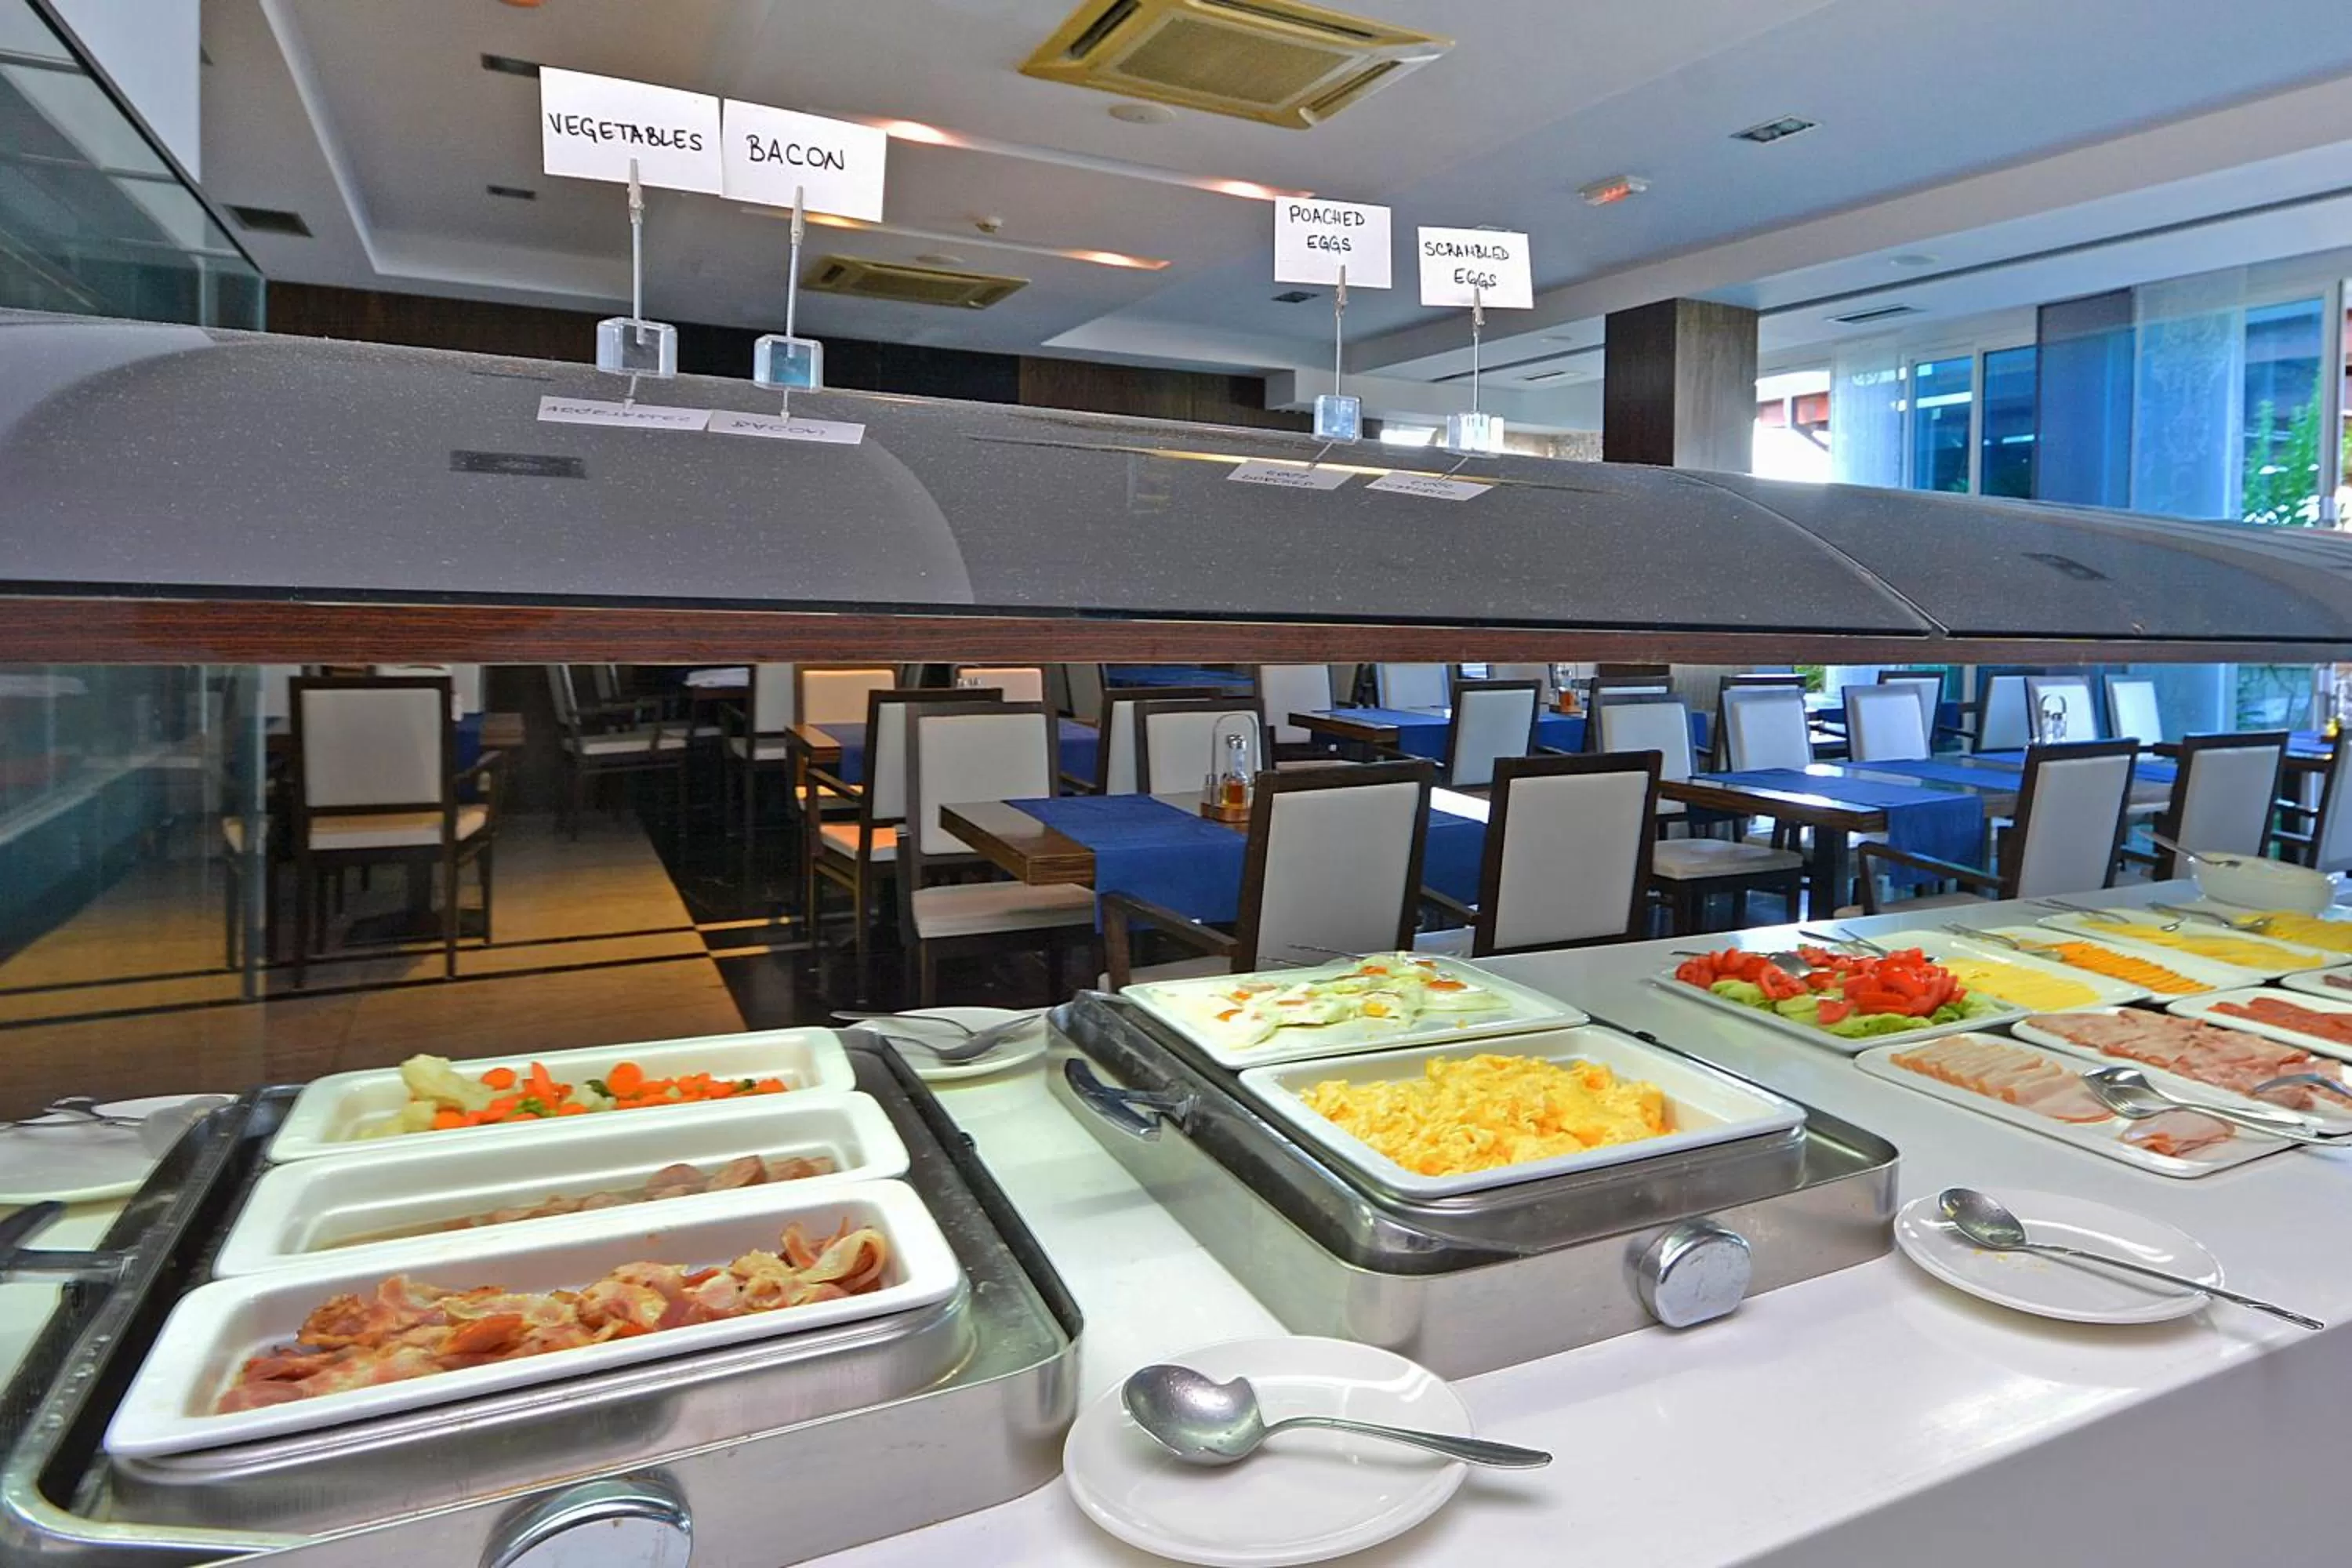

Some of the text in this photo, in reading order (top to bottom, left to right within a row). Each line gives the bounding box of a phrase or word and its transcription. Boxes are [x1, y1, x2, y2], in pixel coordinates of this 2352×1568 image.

[548, 112, 703, 152] VEGETABLES
[746, 134, 845, 171] BACON
[1289, 205, 1366, 227] POACHED
[1307, 234, 1352, 255] EGGS
[1424, 241, 1510, 261] SCRAMBLED
[1454, 268, 1497, 290] EGGS
